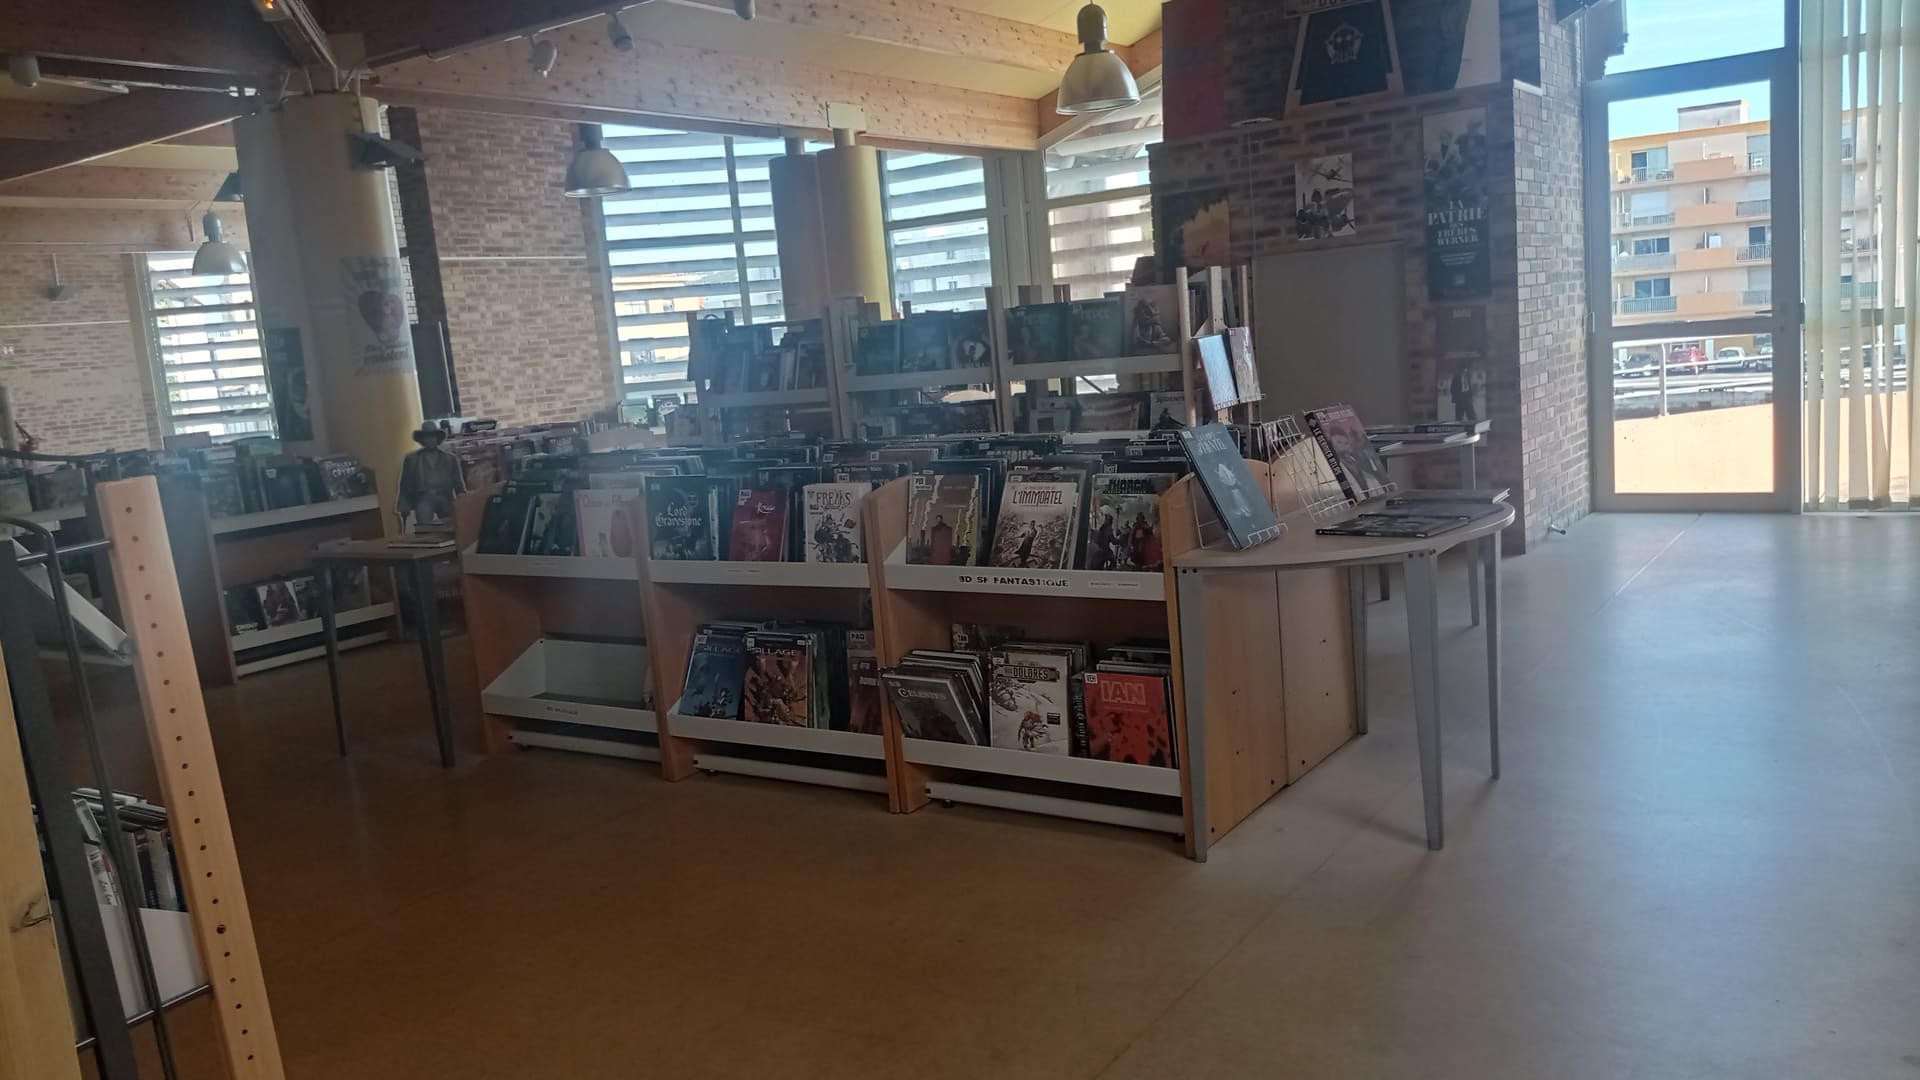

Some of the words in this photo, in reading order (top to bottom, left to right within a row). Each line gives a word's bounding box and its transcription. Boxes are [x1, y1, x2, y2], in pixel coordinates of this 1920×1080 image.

[816, 489, 852, 506] FREAKS
[1011, 490, 1064, 506] L'IMMORTEL
[667, 501, 688, 516] Lord
[993, 576, 1069, 587] FANTASTIQUE
[751, 647, 798, 657] SILLAGE
[1013, 666, 1049, 680] DOLORES
[1100, 680, 1147, 706] IAN
